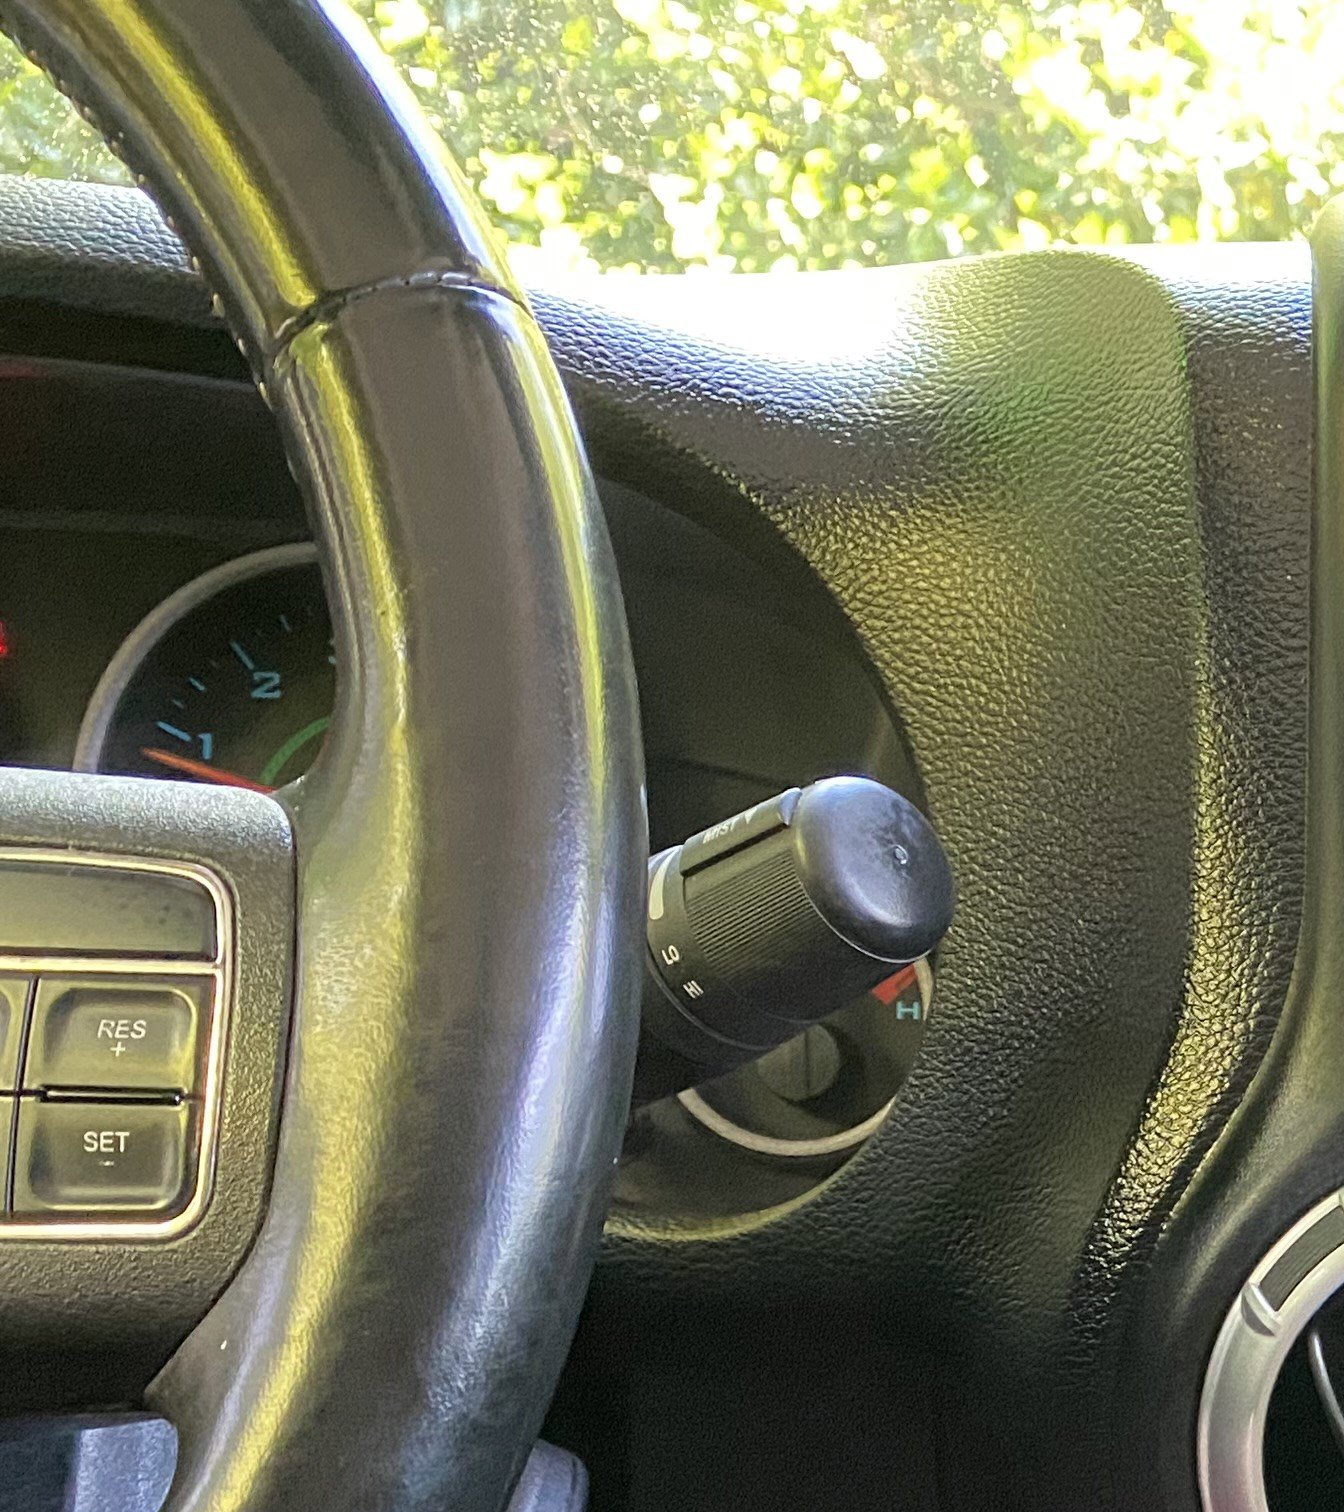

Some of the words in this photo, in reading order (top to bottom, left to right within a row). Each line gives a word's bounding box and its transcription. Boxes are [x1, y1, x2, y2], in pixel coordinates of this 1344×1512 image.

[251, 671, 281, 698] 2
[199, 733, 213, 760] 1
[702, 816, 739, 845] MIST
[682, 980, 704, 999] HI
[896, 1000, 921, 1020] H
[97, 1019, 147, 1040] RES
[83, 1130, 131, 1153] SET
